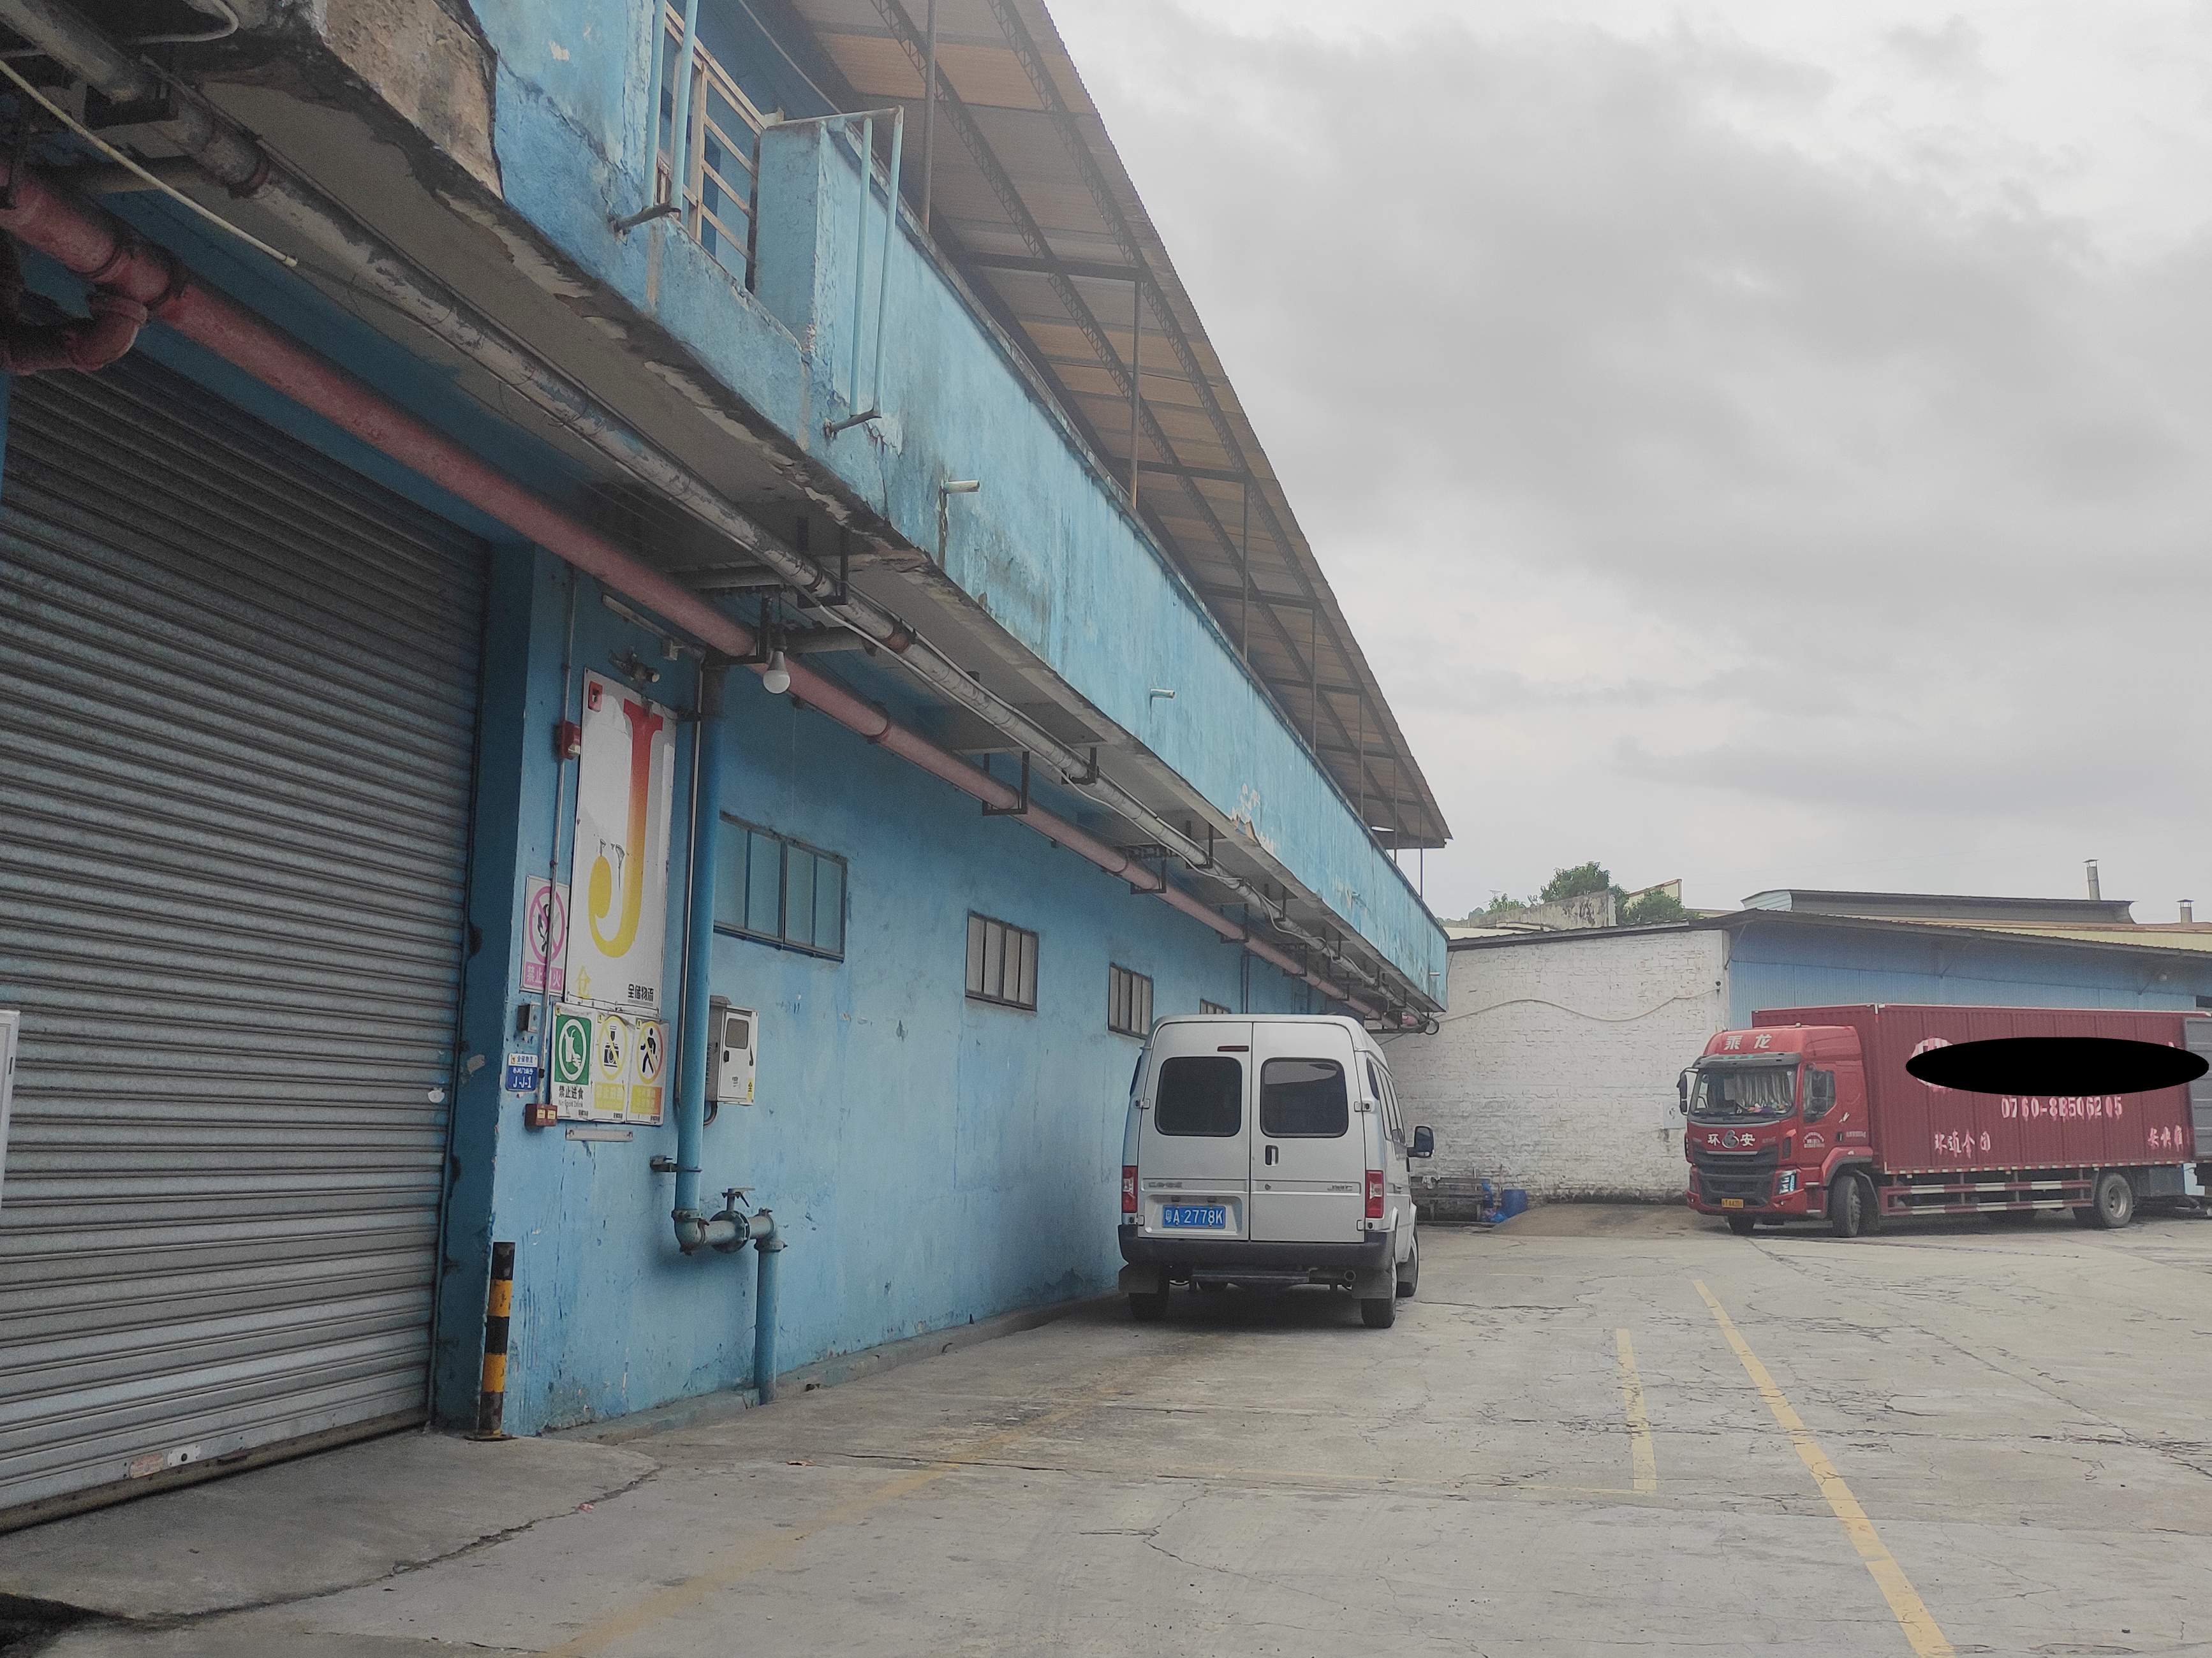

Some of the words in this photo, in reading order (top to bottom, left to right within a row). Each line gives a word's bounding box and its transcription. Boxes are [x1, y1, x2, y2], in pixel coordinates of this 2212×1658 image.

[588, 698, 663, 958] J
[527, 965, 561, 987] 禁止火
[628, 983, 654, 1002] 全储物流
[1723, 1034, 1772, 1050] 乘龙
